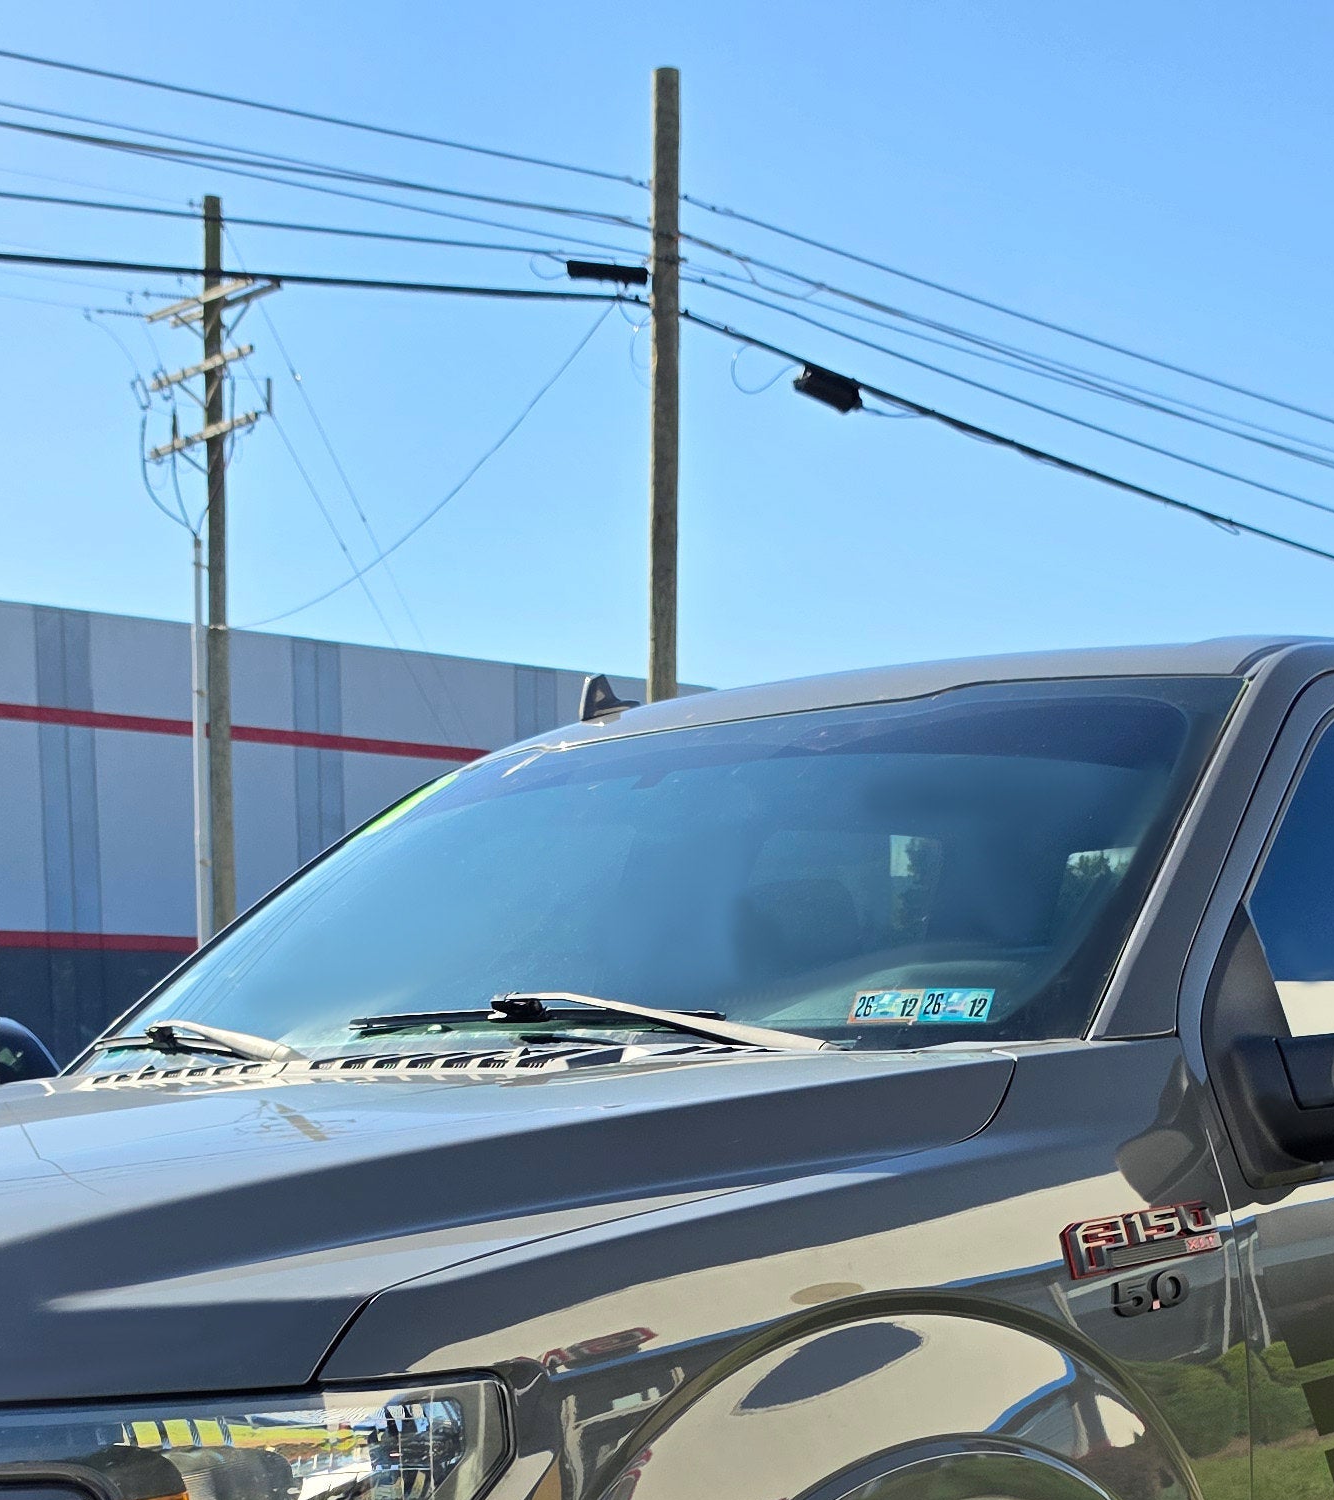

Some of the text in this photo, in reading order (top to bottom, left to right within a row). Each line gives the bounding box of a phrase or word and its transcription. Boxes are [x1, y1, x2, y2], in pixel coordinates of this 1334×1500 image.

[855, 996, 919, 1017] 26 12
[923, 993, 988, 1017] 26 12
[1187, 1236, 1216, 1252] XLT
[1113, 1270, 1190, 1318] 5.0
